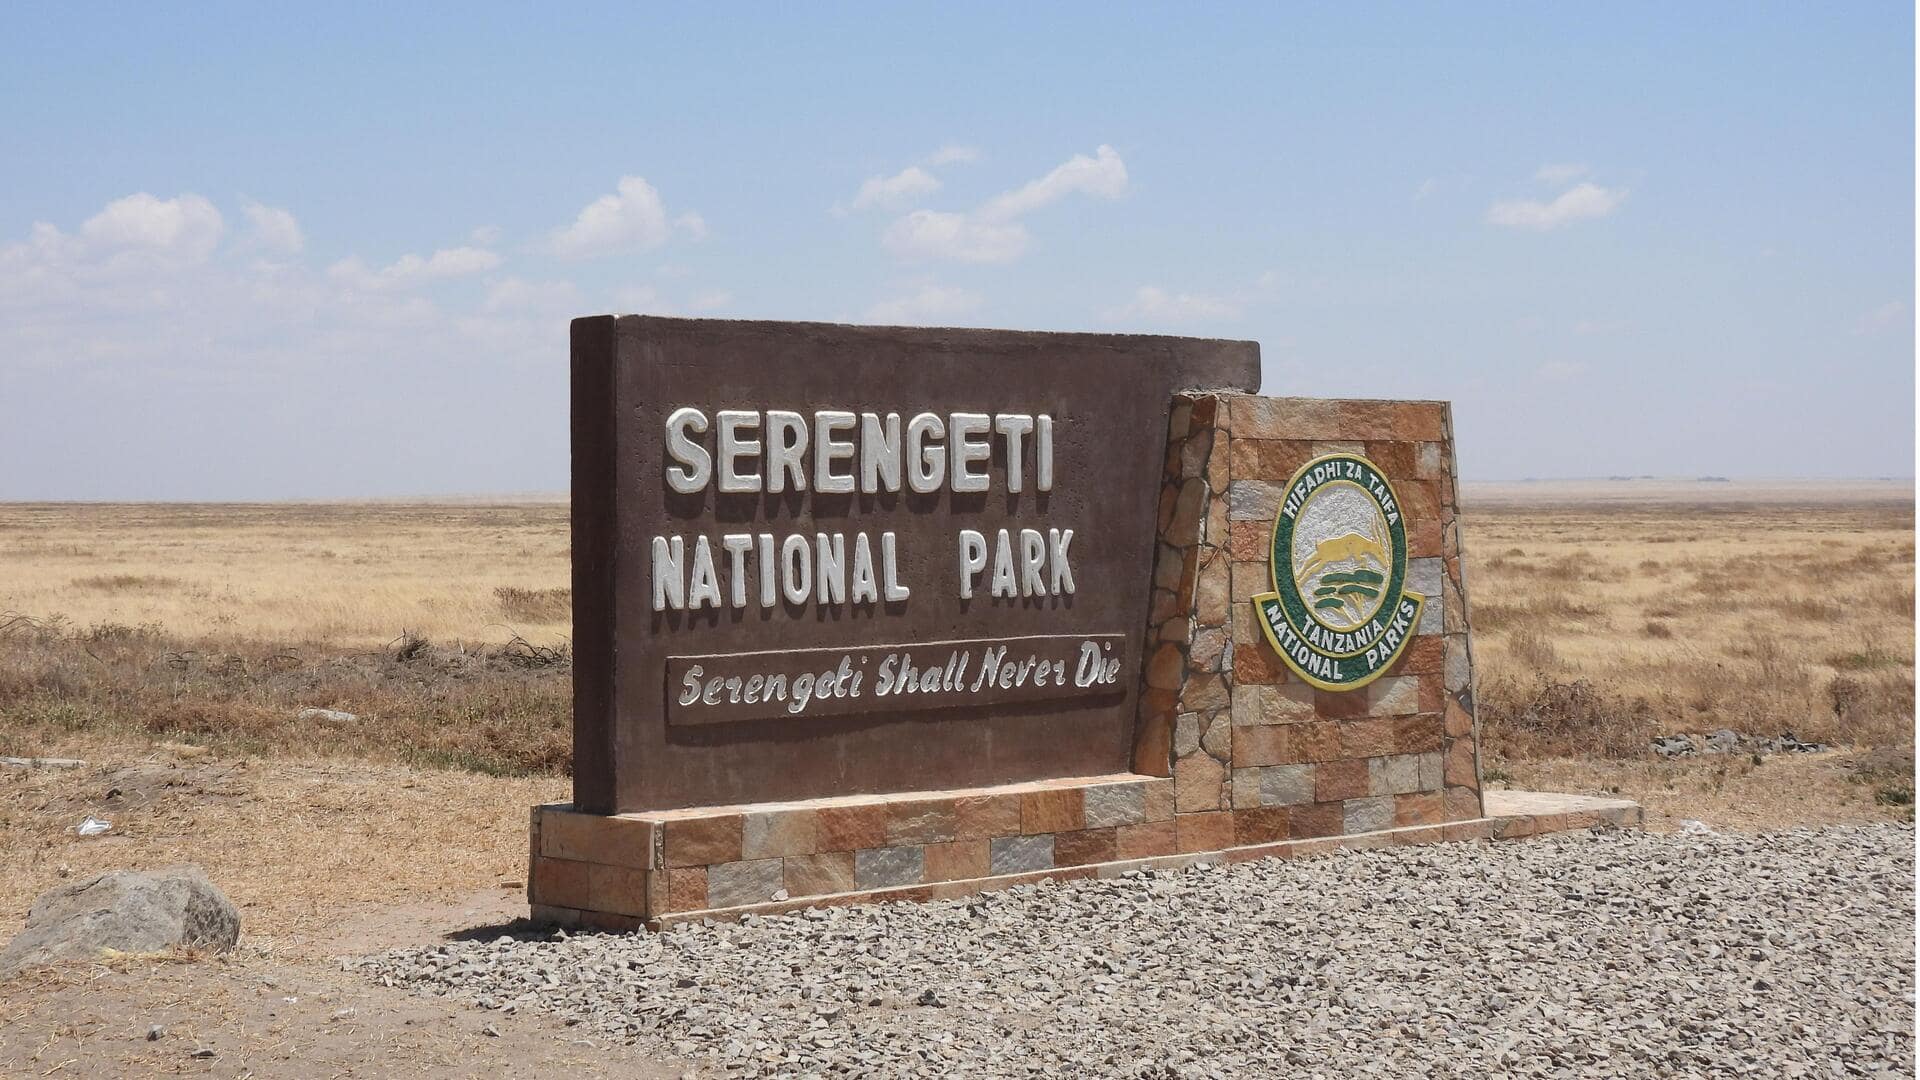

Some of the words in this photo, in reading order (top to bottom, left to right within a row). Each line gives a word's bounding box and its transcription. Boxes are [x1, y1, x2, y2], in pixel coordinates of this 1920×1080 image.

[666, 407, 1053, 494] SERENGETI
[1282, 461, 1341, 520] HIFADHI
[1346, 461, 1363, 480] ZA
[1368, 473, 1400, 527] TAIFA
[652, 531, 910, 611] NATIONAL
[959, 528, 1075, 600] PARK
[1266, 604, 1343, 680] NATIONAL
[1365, 600, 1416, 671] PARKS
[1299, 614, 1384, 654] TANZANIA
[678, 656, 867, 714] Serengeti
[875, 650, 965, 696] Shall
[972, 645, 1066, 692] Never
[1075, 640, 1120, 688] Die
